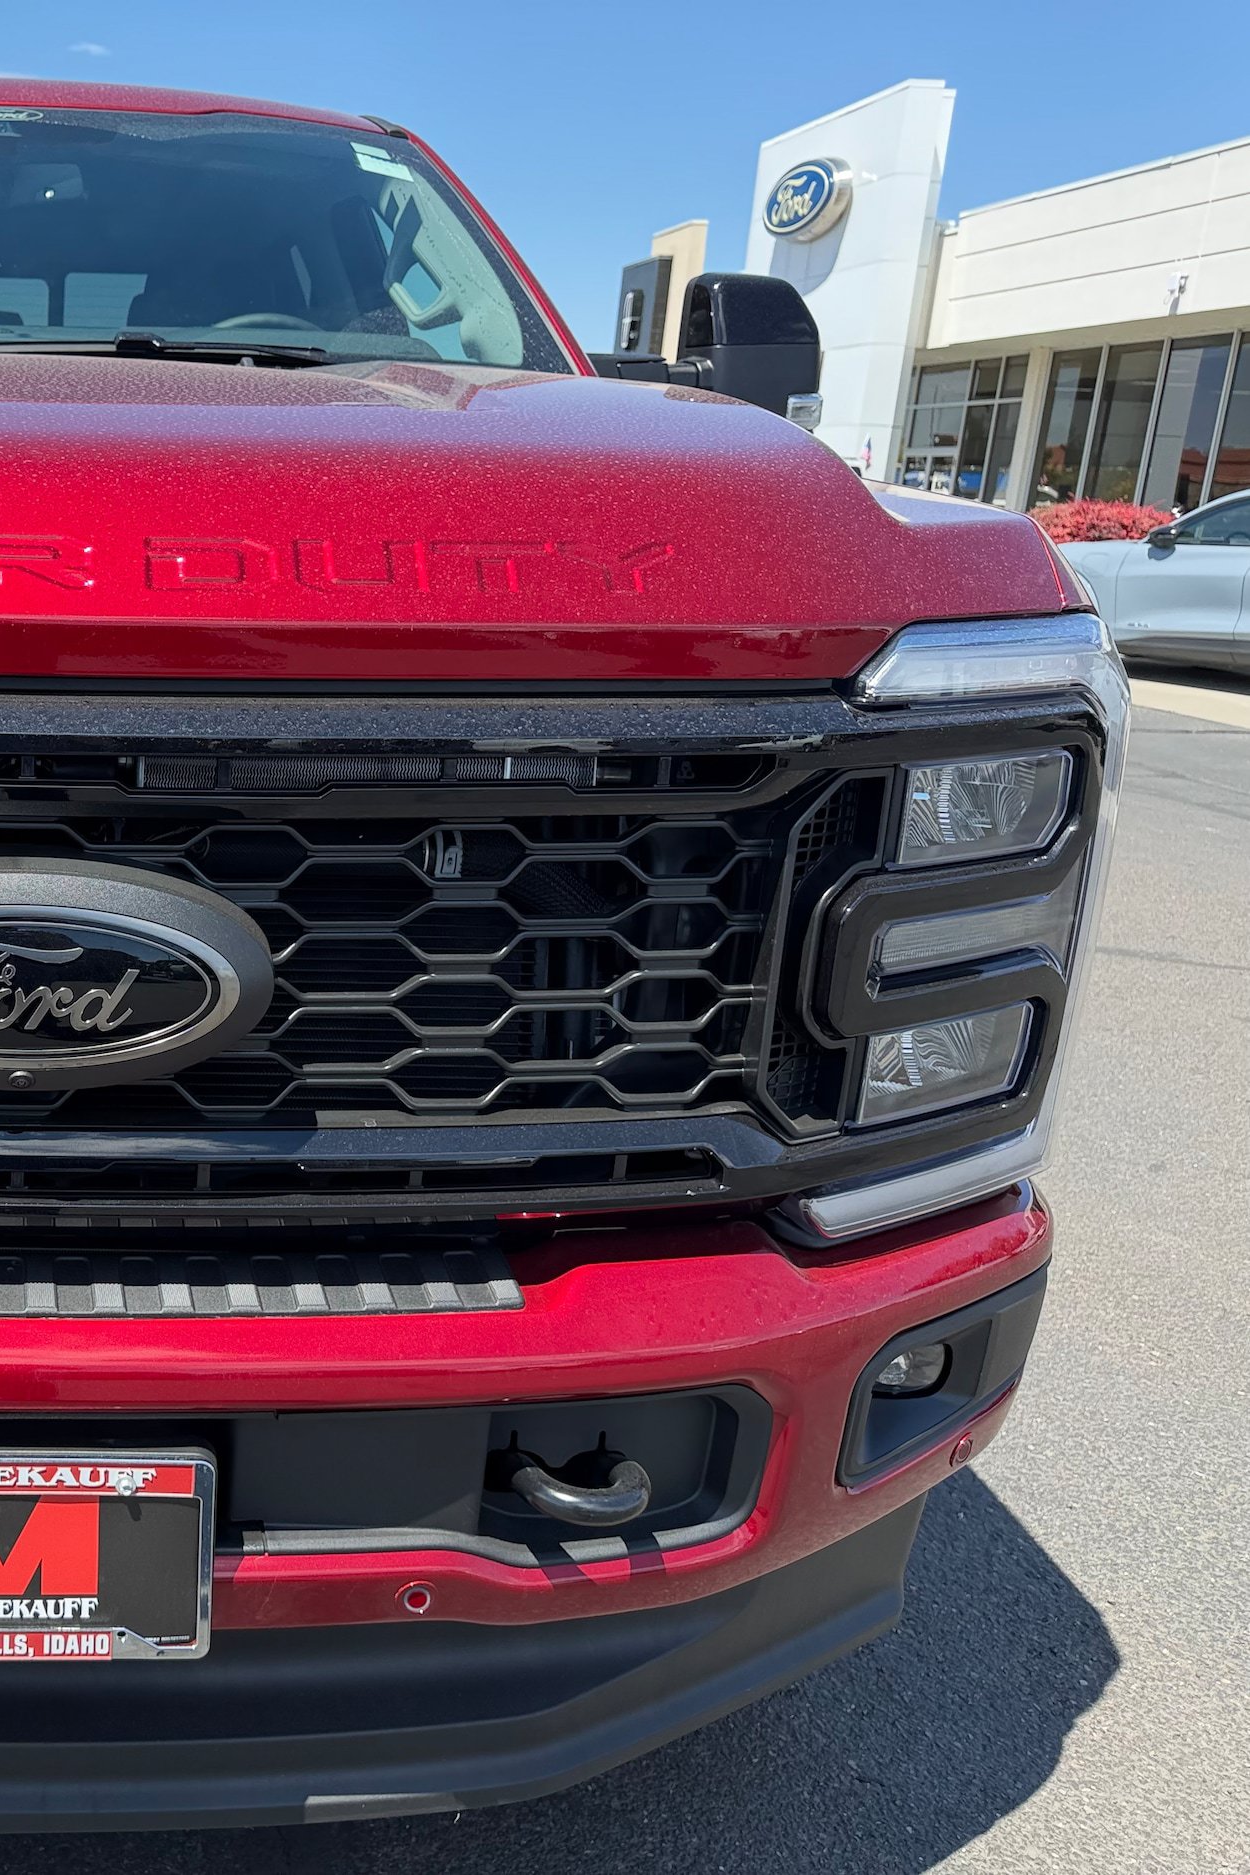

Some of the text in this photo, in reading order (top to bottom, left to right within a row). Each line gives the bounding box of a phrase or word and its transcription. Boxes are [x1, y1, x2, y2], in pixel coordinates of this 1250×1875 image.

[770, 174, 818, 226] Ford
[144, 536, 674, 594] DUTY
[43, 1633, 110, 1656] IDAHO
